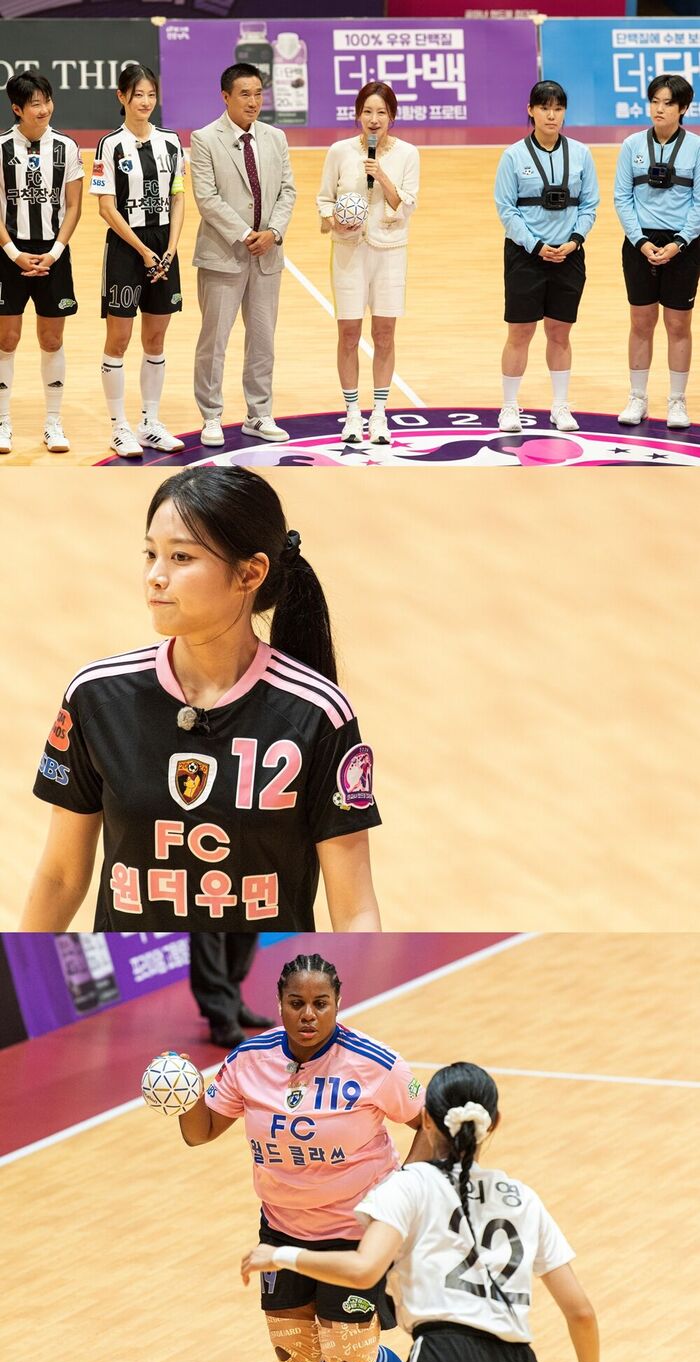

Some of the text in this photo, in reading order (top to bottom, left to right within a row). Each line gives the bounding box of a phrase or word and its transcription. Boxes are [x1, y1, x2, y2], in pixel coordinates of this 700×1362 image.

[344, 33, 452, 46] 100% 우유 단백질
[663, 32, 685, 45] 수분
[52, 60, 140, 90] THI
[429, 105, 467, 120] 프로틴
[25, 172, 42, 189] FC
[143, 180, 160, 198] FC
[7, 187, 60, 205] 구척장신
[231, 737, 302, 810] 12
[154, 819, 231, 863] FC
[110, 862, 279, 921] 원더우먼
[313, 1076, 362, 1111] 119
[270, 1113, 316, 1141] FC
[250, 1139, 346, 1167] 월드 클라쓰
[444, 1205, 531, 1306] 22
